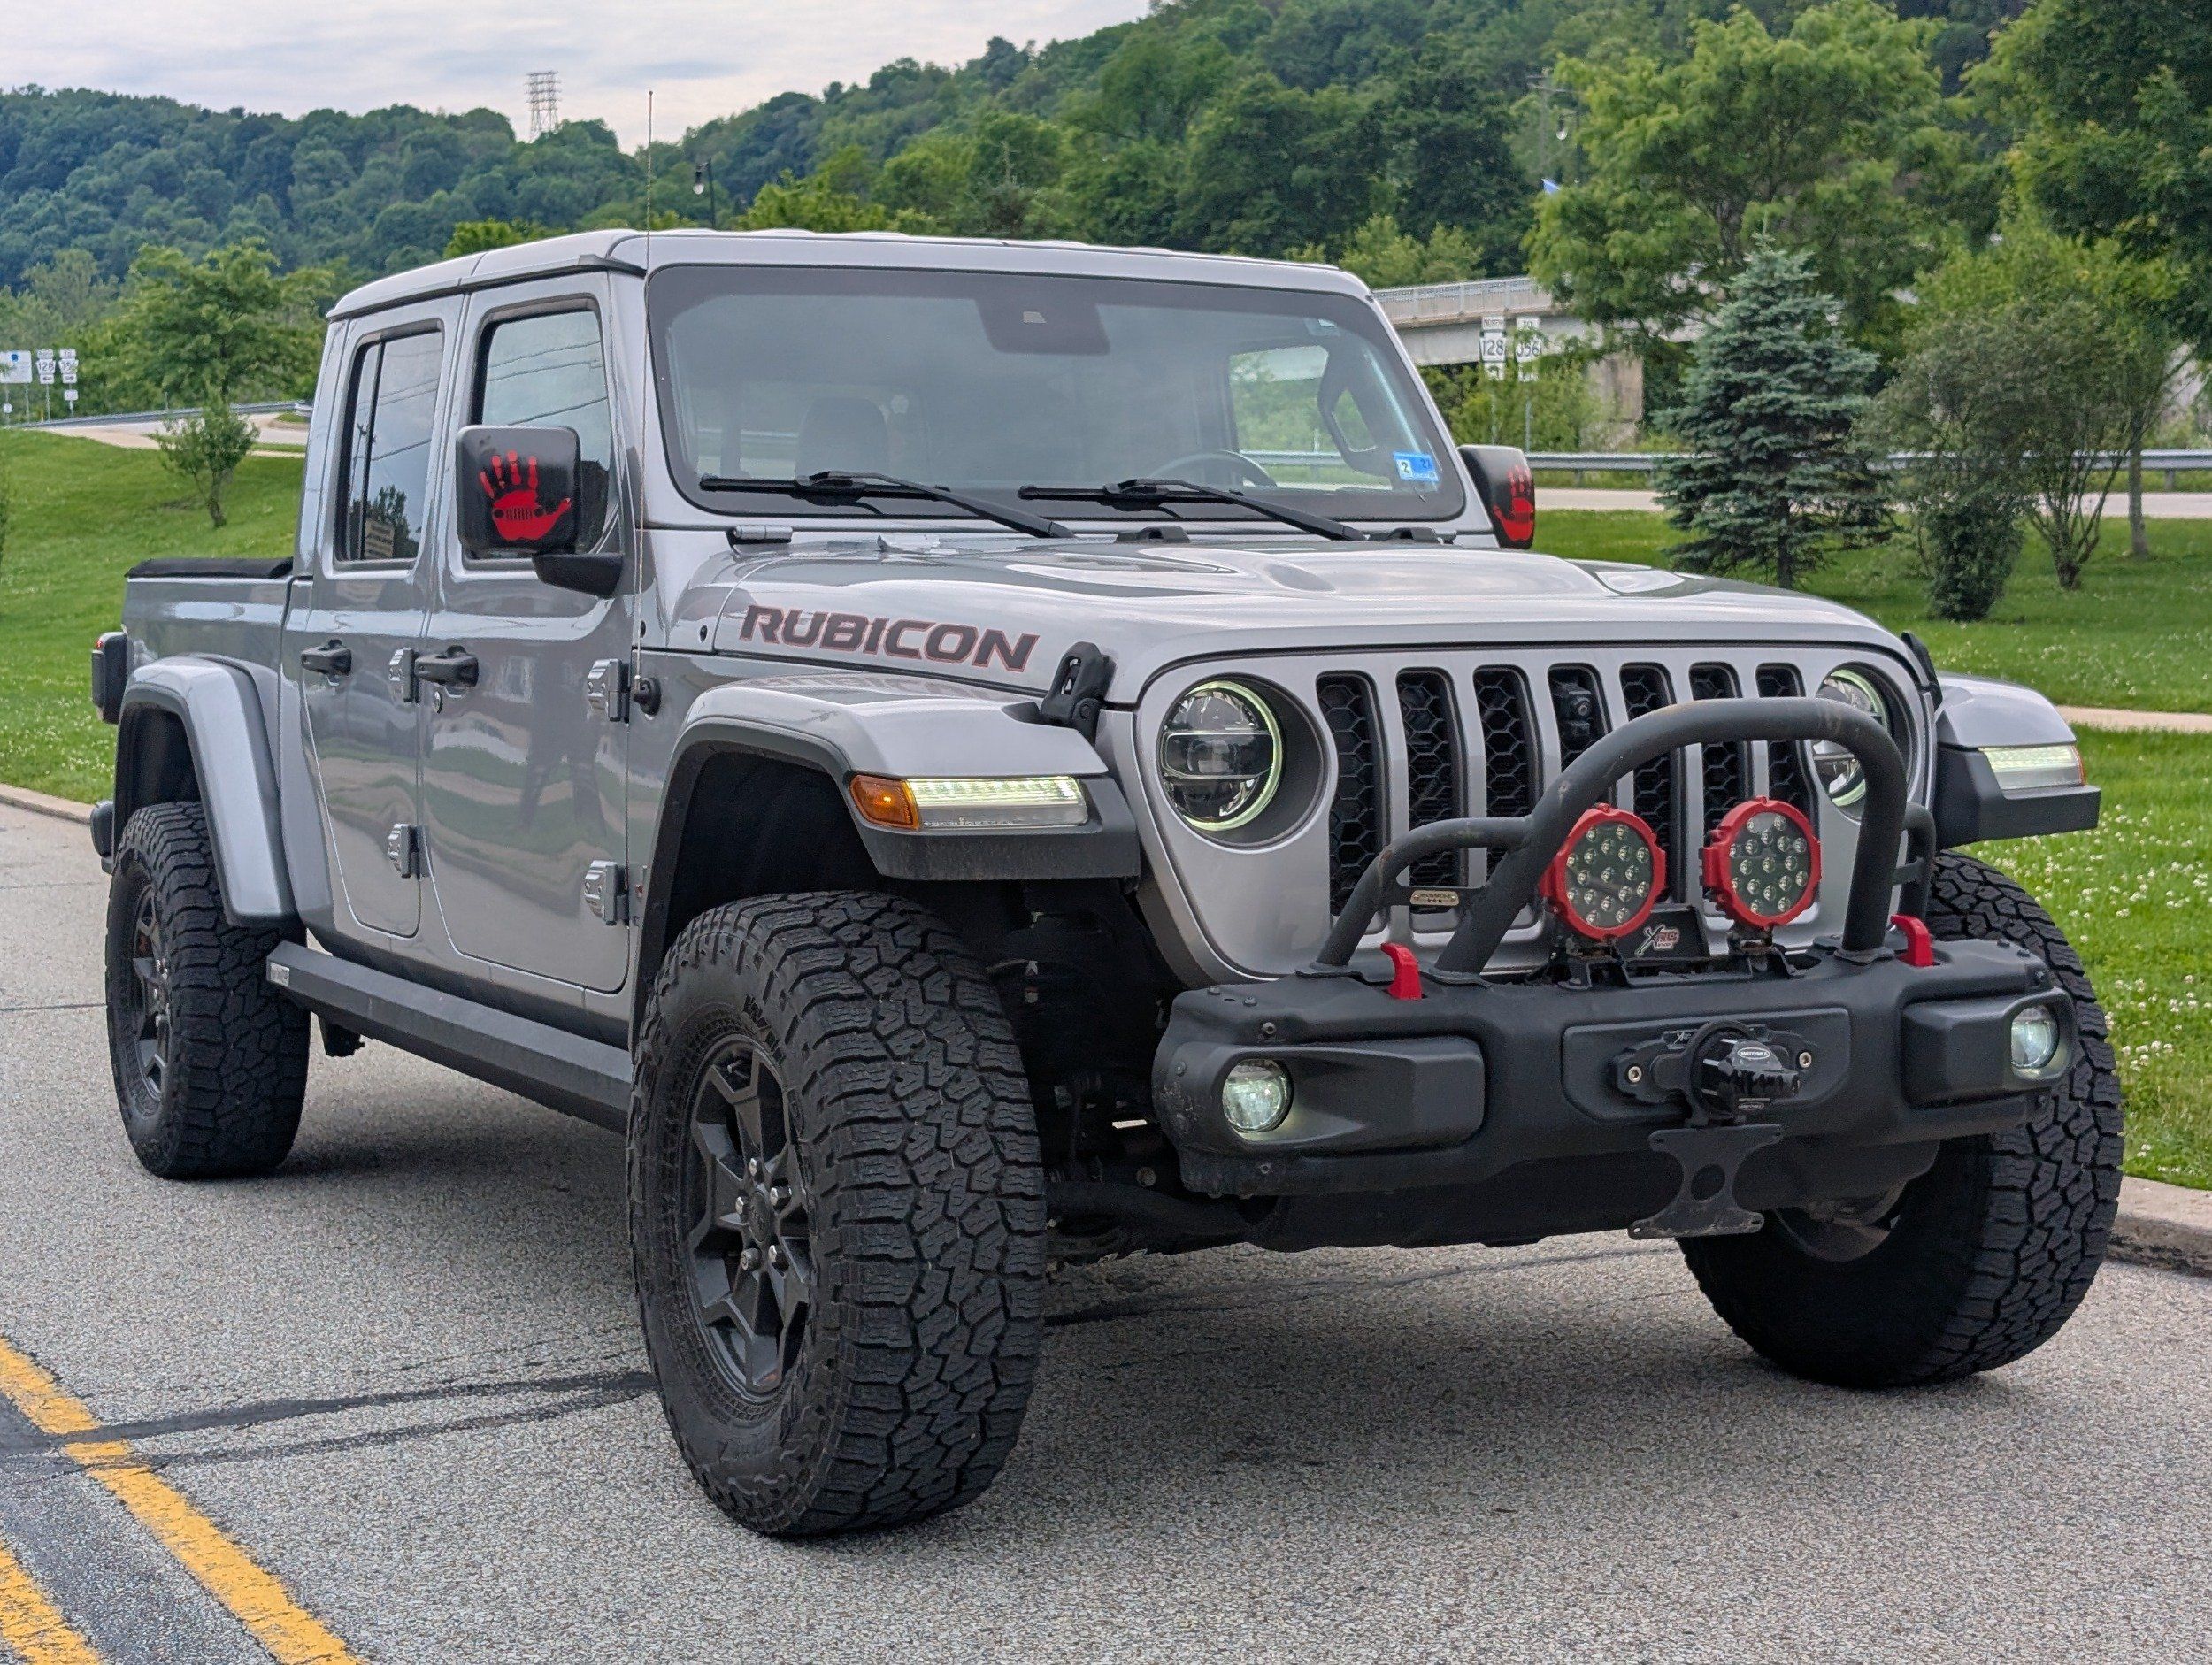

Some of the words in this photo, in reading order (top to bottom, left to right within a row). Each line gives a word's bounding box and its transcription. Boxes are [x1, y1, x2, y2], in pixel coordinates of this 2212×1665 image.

[1481, 340, 1504, 356] 128
[1401, 461, 1410, 474] 2
[738, 604, 1041, 673] RUBICON
